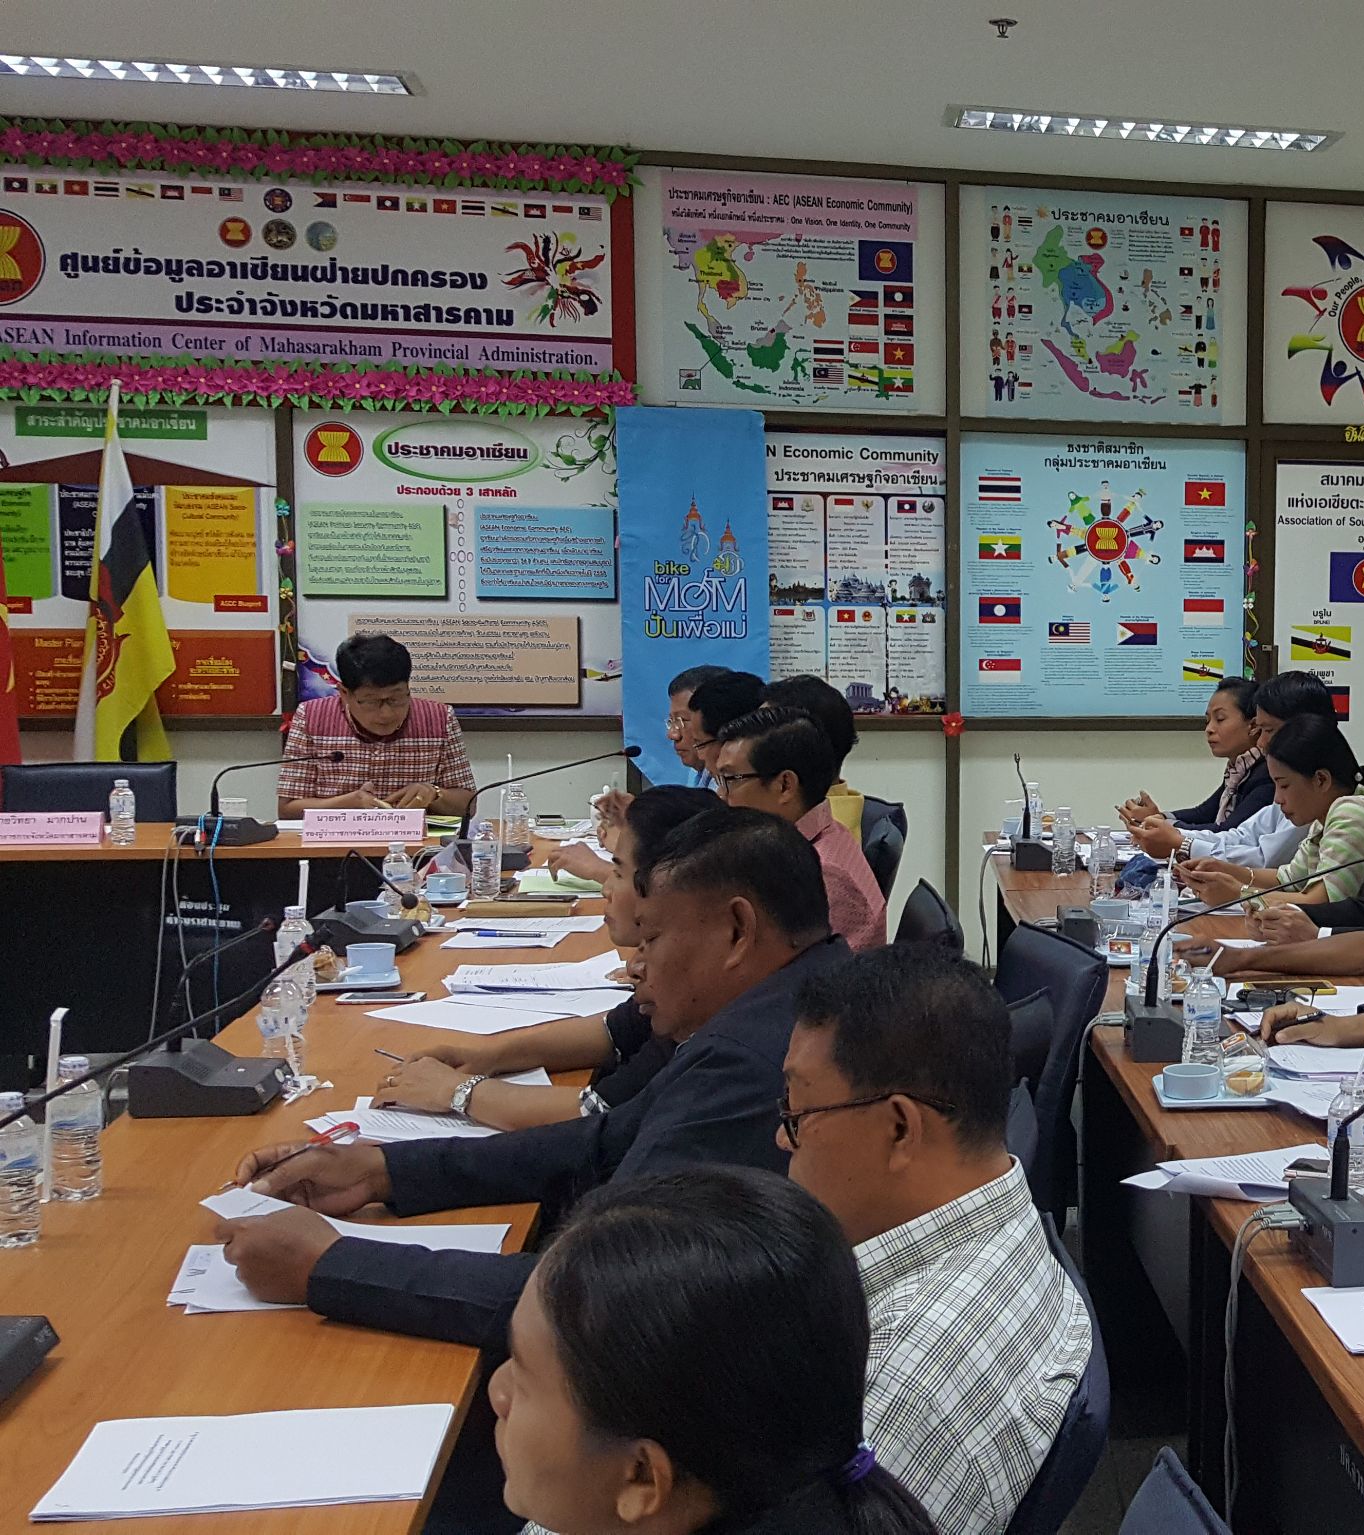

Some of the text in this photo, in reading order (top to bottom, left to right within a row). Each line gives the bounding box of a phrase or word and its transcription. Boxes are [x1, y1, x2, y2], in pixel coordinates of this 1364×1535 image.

[772, 194, 790, 206] AEC
[793, 194, 823, 209] (ASEAN
[826, 198, 864, 211] Economic
[867, 199, 913, 215] Community)
[825, 218, 838, 227] One
[864, 220, 877, 229] One
[878, 221, 911, 232] Community
[1050, 208, 1170, 227] ประชาคมอาเซียน
[59, 247, 488, 290] ศูนย์ข้อมูลอาเซียนฝ่ายปกครอง
[174, 290, 515, 328] ประจำจังหวัดมหาสารคาม
[1327, 300, 1342, 318] Our
[64, 328, 162, 349] Information
[171, 332, 227, 351] Center
[234, 335, 252, 352] of
[259, 336, 383, 357] Mahasarakham
[391, 341, 470, 361] Provincial
[478, 346, 598, 366] Administration.
[387, 441, 529, 460] ประชาคมอาเซียน
[783, 445, 854, 461] Economic
[859, 447, 940, 465] Community
[1066, 440, 1144, 455] ธงชาติสมาชิก
[1044, 456, 1167, 472] กลุ่มประชาคมอาเซียน
[774, 468, 939, 489] ประชาคมเศรษฐกิจอาเซียน
[396, 484, 517, 498] ประกอบด้วย 3 เสาหลัก
[1277, 515, 1333, 527] Association
[1335, 516, 1346, 527] of
[654, 560, 690, 576] bike
[656, 575, 671, 585] for
[644, 575, 746, 612] MOM
[1312, 608, 1332, 620] บรูไน
[644, 609, 747, 639] ปั่นเพื่อแม่
[316, 812, 347, 823] นายทวี
